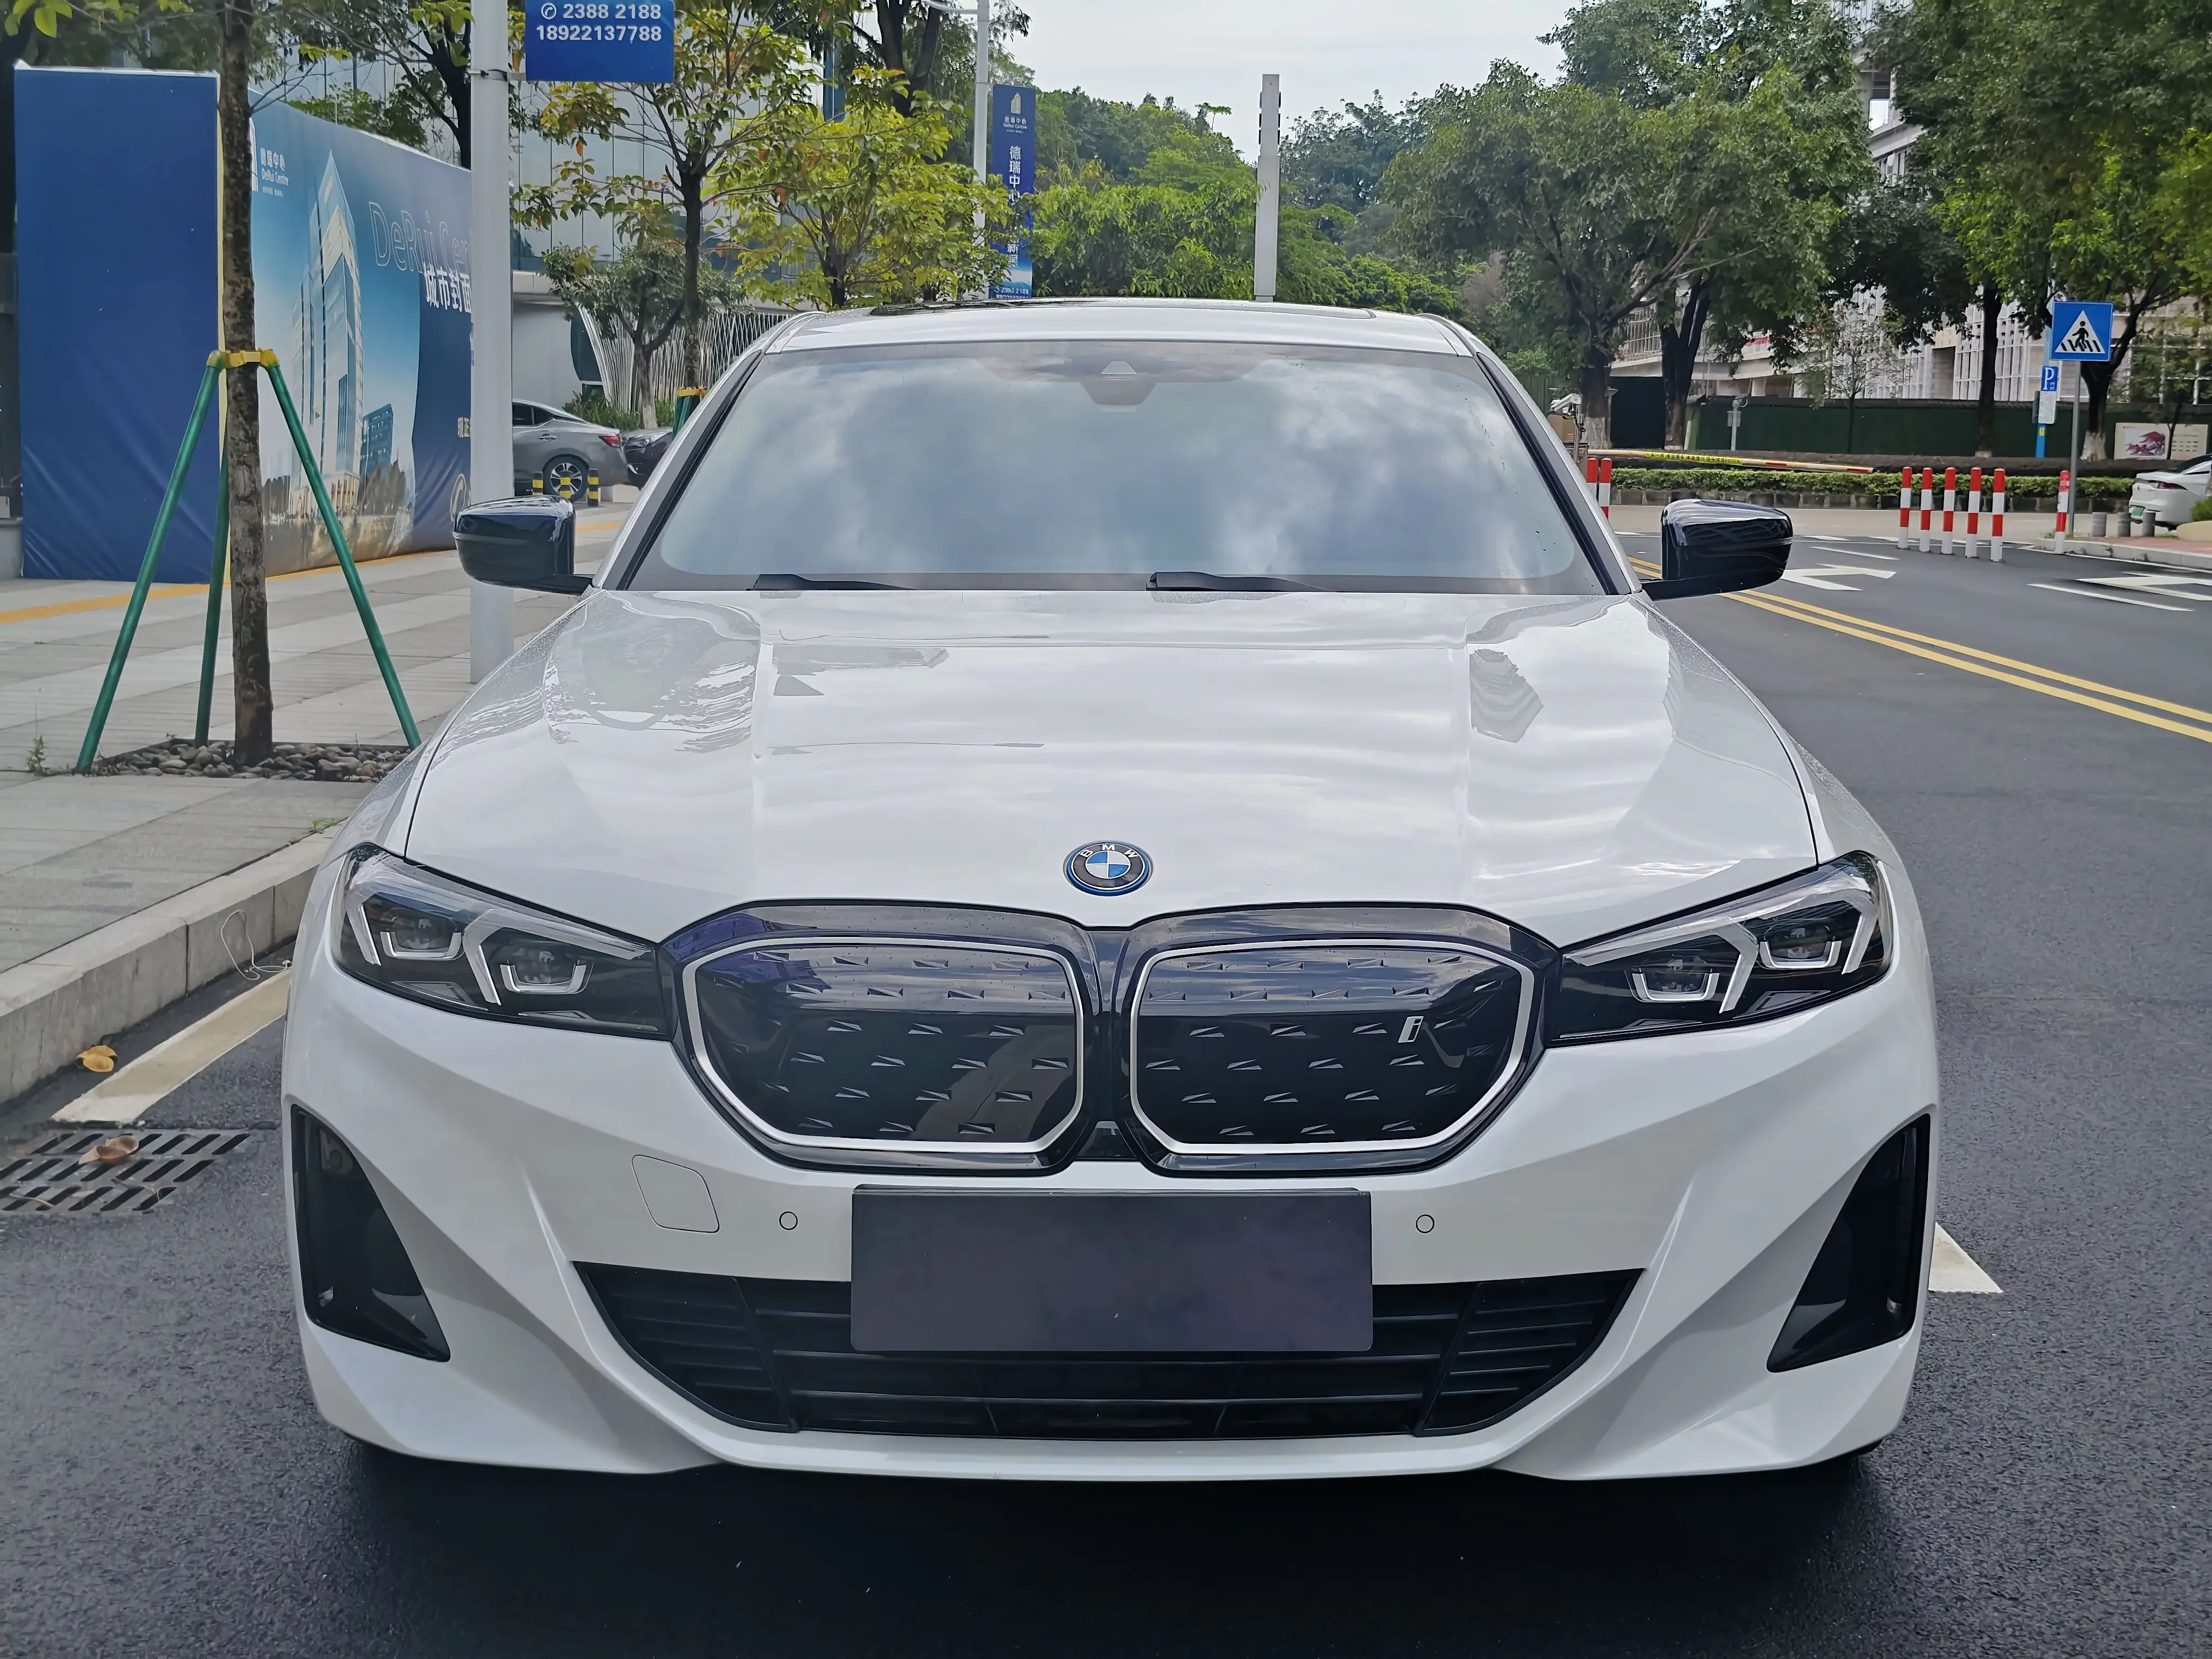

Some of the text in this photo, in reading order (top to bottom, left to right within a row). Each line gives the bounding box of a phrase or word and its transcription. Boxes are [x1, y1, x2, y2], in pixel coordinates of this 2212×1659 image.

[563, 3, 662, 19] 2388 2188
[536, 25, 662, 43] 18922137788
[2043, 367, 2054, 390] P
[1079, 844, 1138, 858] BMW
